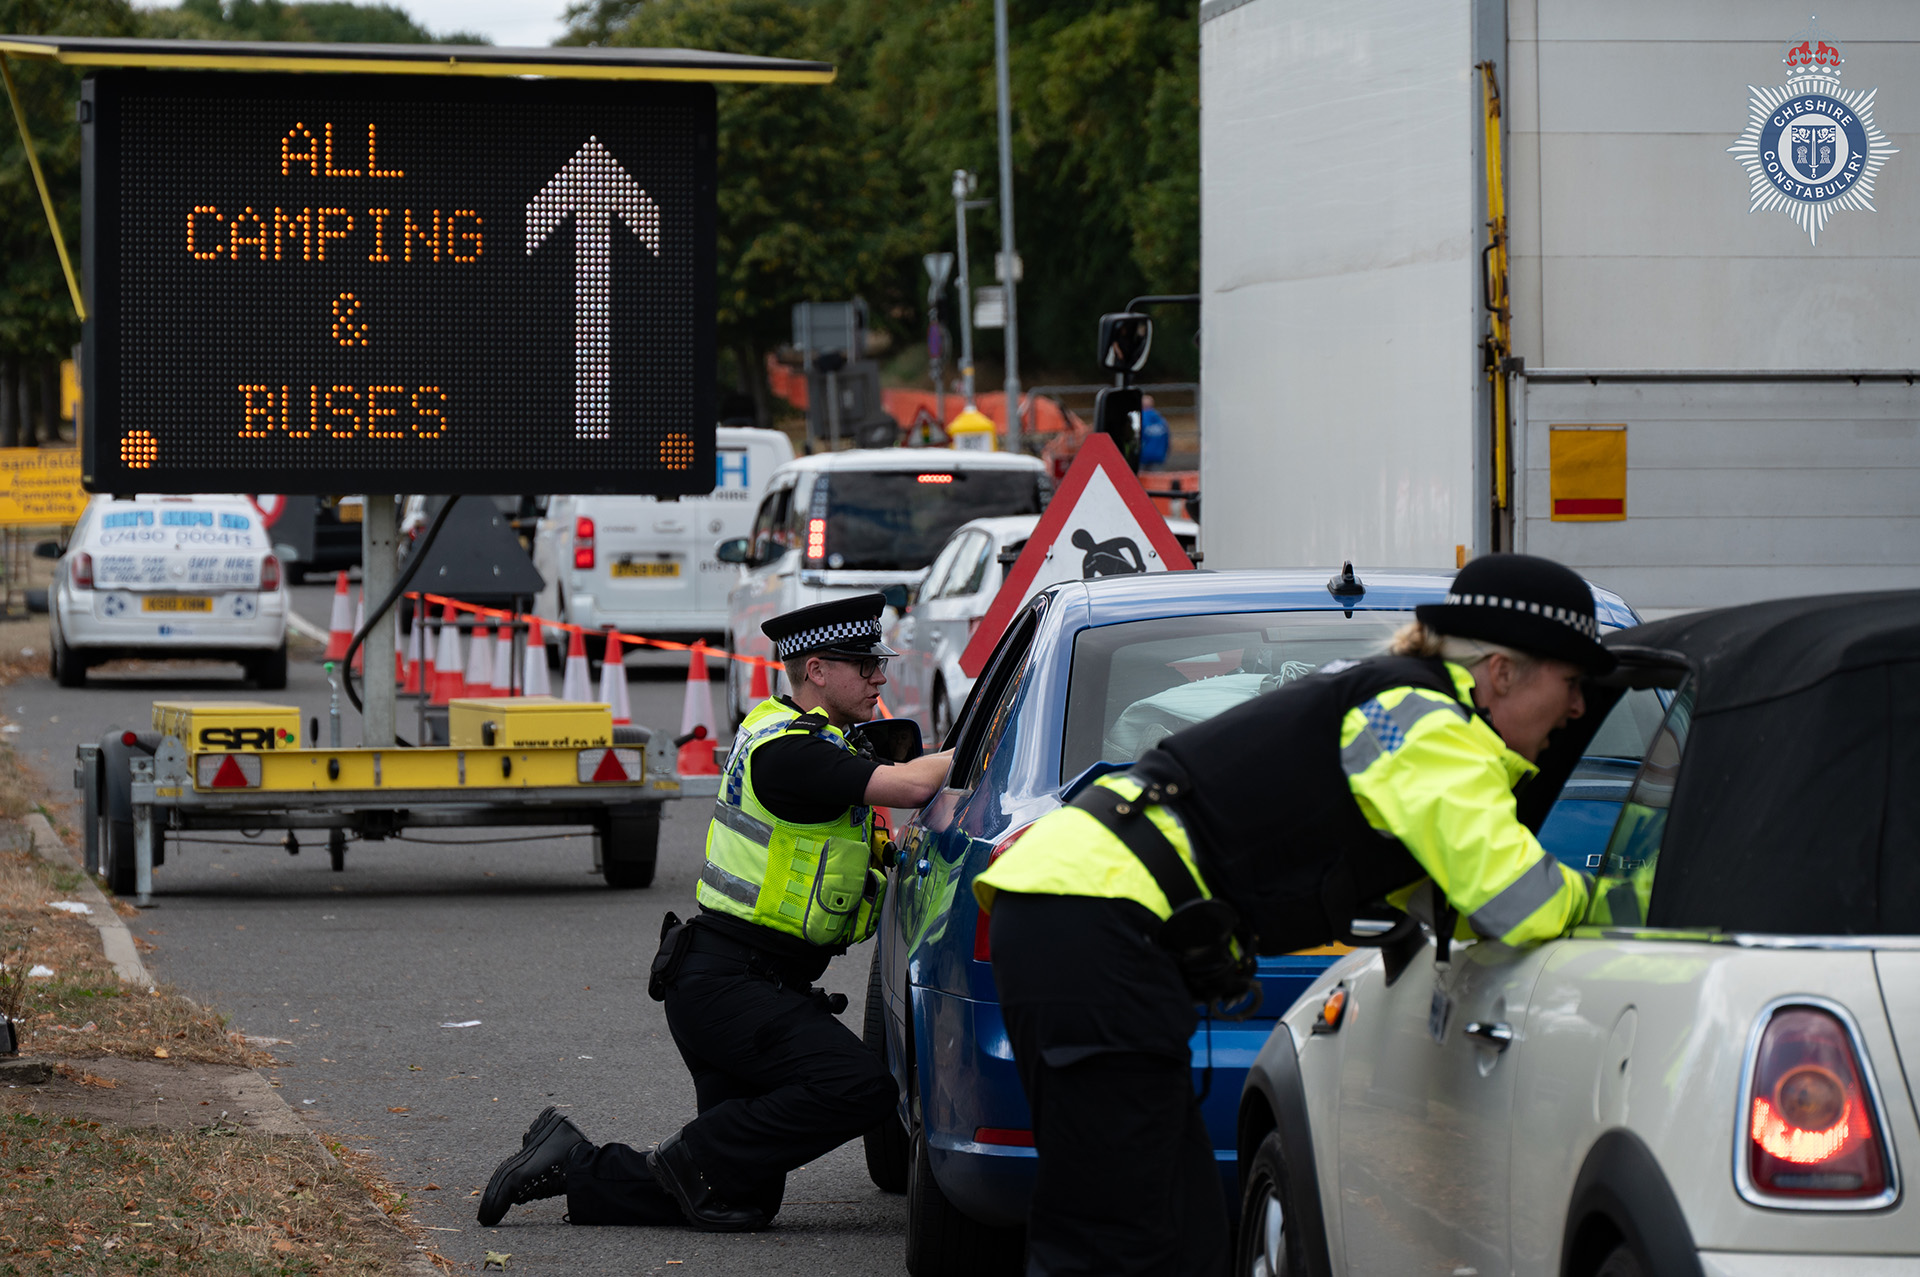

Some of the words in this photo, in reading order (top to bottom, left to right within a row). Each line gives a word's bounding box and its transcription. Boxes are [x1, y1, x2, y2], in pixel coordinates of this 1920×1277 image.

[281, 121, 405, 178] ALL
[186, 206, 484, 263] CAMPING
[332, 292, 369, 347] &
[237, 384, 448, 439] BUSES
[513, 736, 608, 748] wwwsrlcouk
